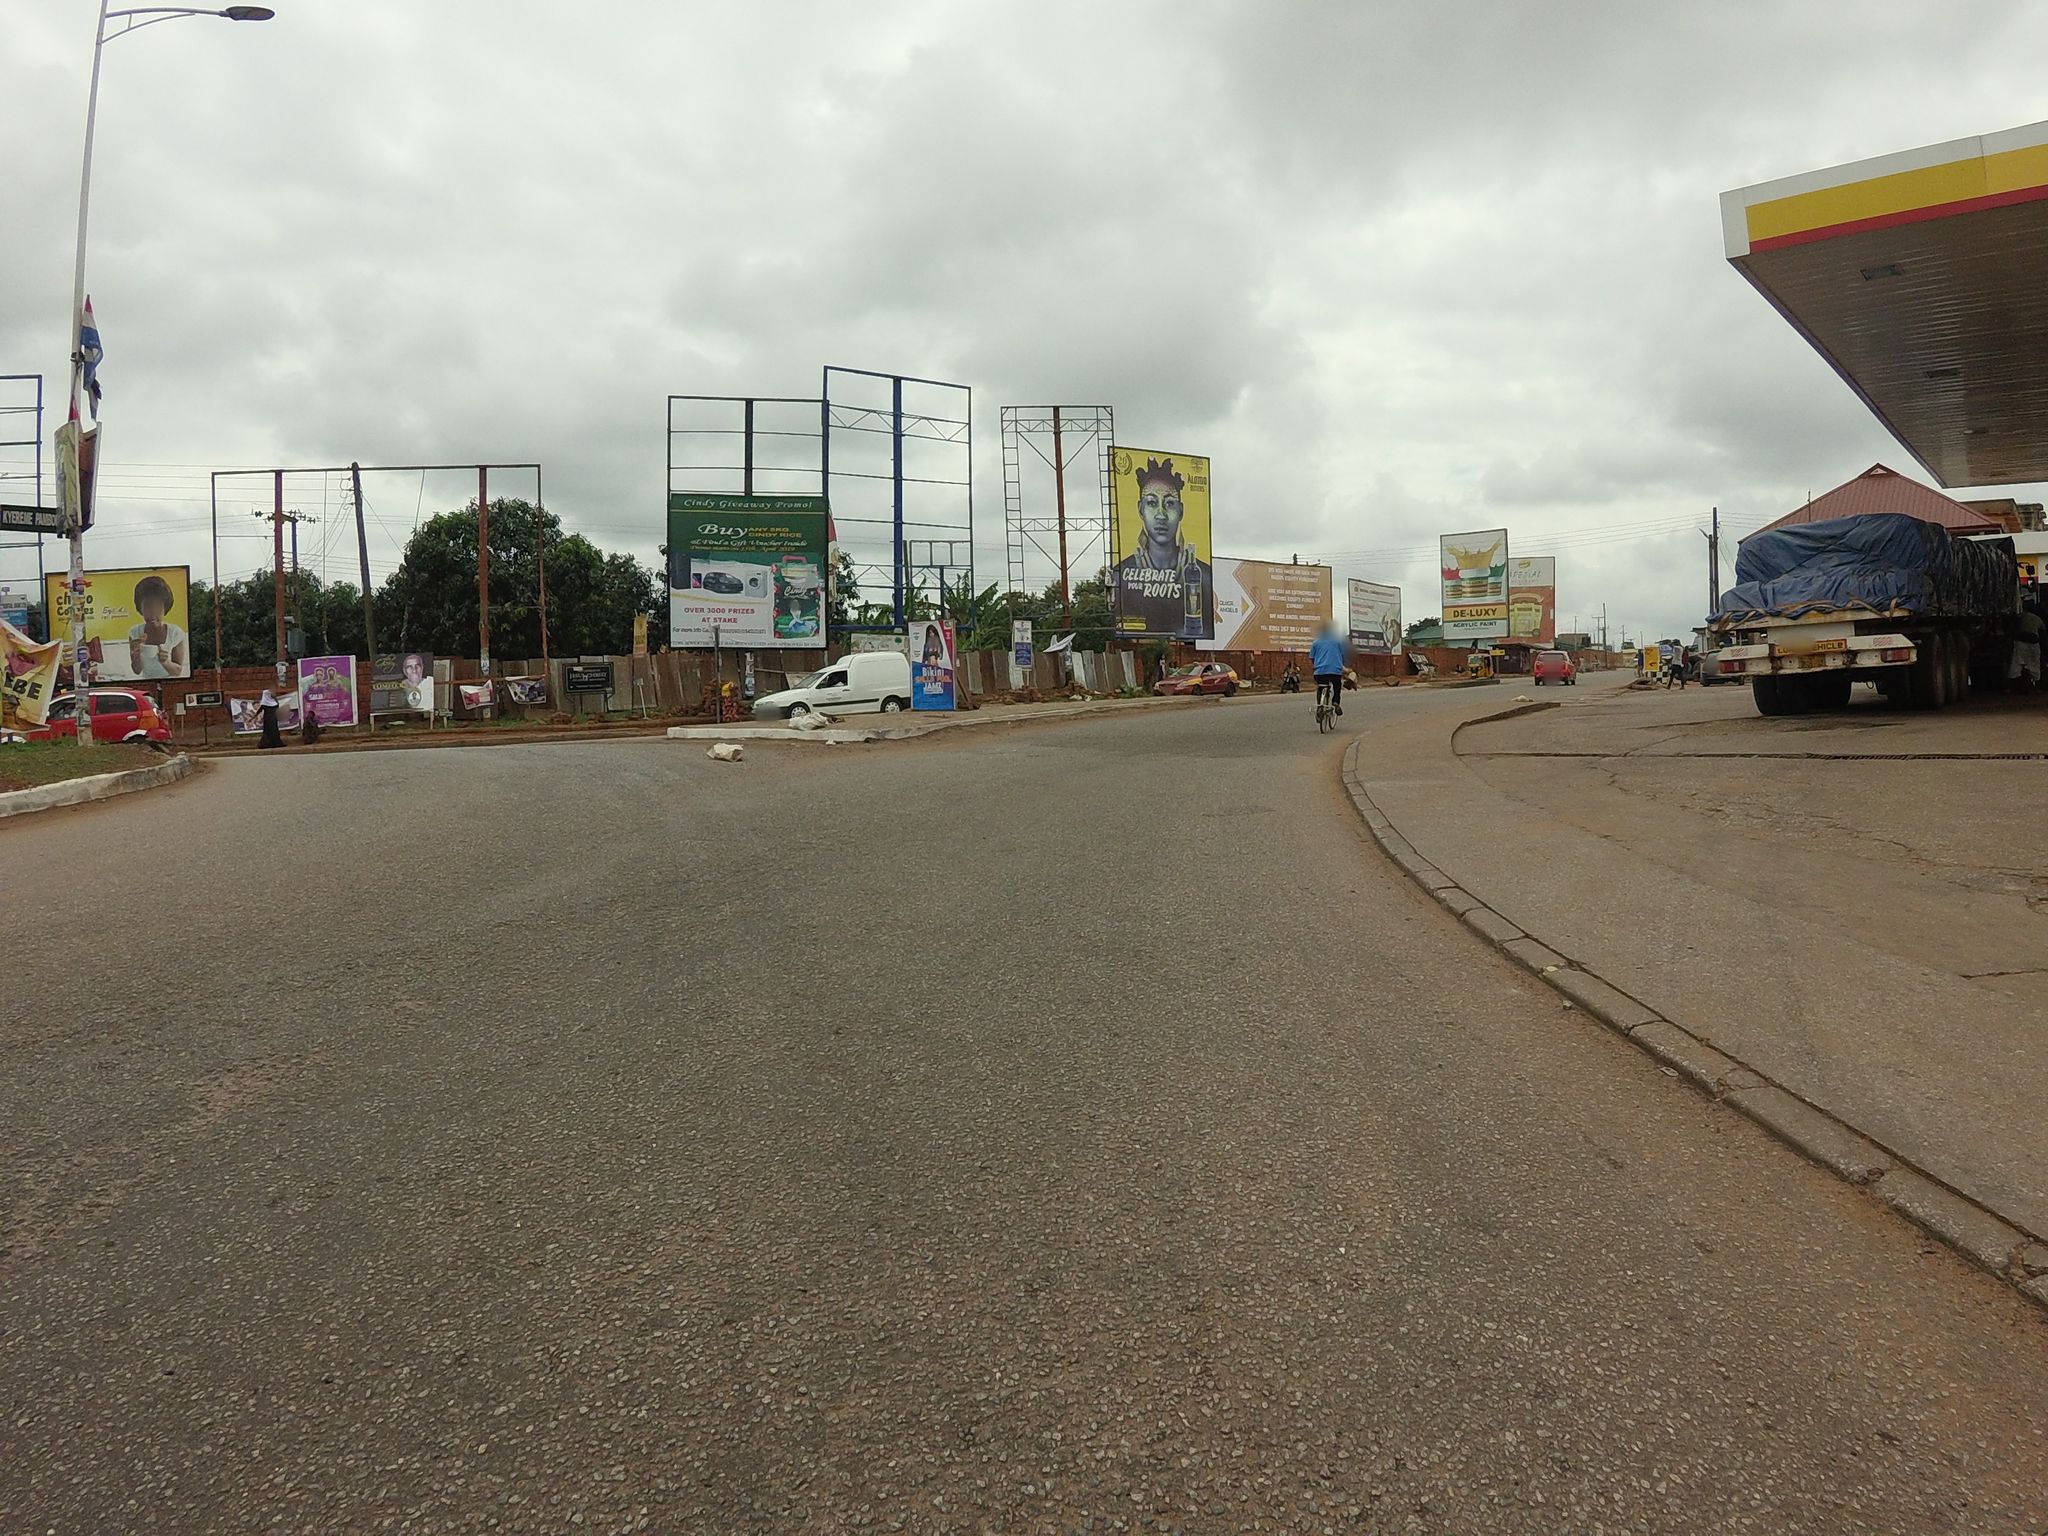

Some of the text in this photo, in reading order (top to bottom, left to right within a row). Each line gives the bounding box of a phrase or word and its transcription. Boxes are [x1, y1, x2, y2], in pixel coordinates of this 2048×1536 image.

[683, 499, 716, 508] Cindy
[719, 500, 771, 509] Giveaway
[697, 523, 748, 539] Buy
[1122, 567, 1176, 582] CELEBRATE
[1128, 581, 1143, 591] YOUR
[1143, 582, 1182, 599] ROOTS
[56, 591, 93, 606] cho
[1453, 607, 1498, 619] DE-LUXY
[1810, 642, 1844, 651] HICLE
[922, 667, 945, 677] Bikini
